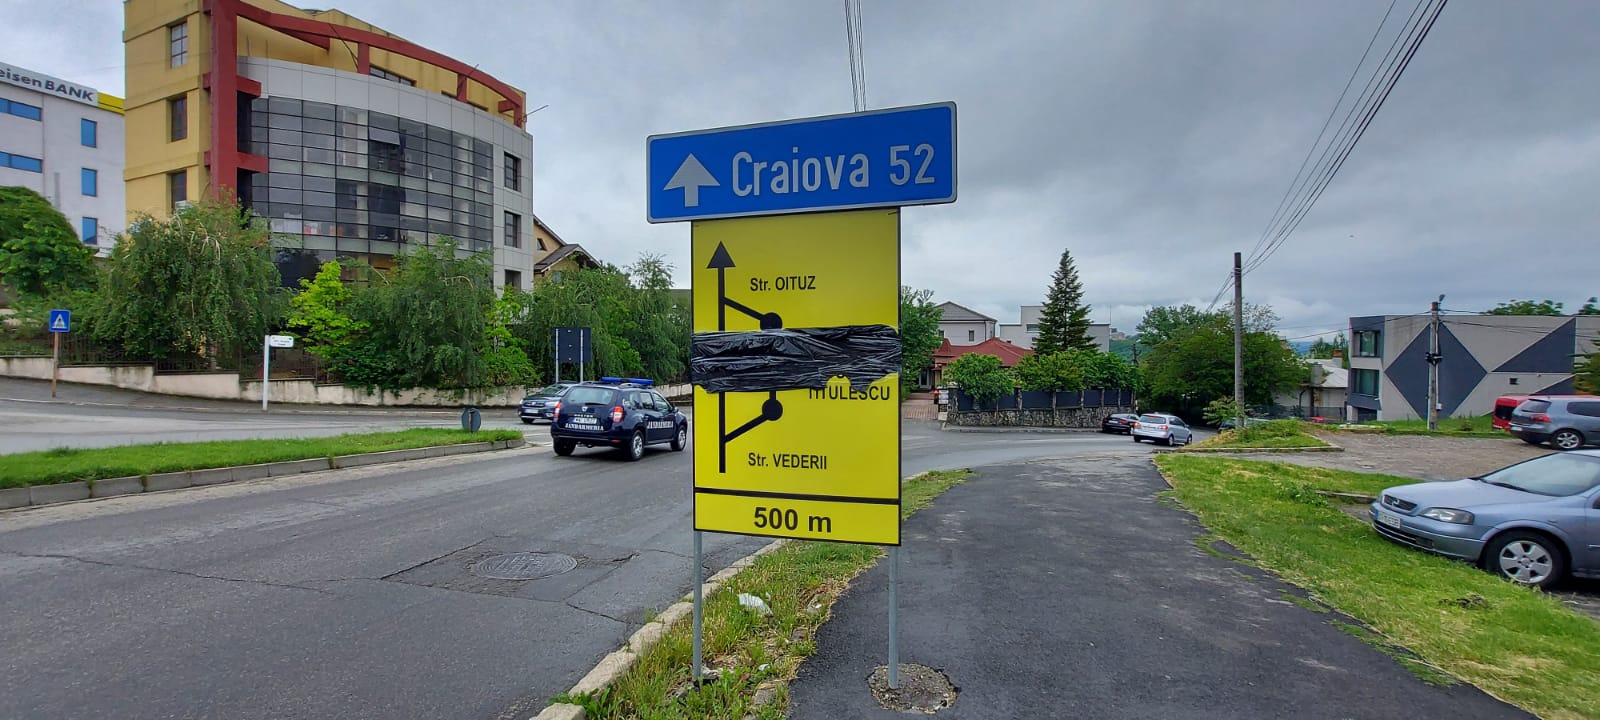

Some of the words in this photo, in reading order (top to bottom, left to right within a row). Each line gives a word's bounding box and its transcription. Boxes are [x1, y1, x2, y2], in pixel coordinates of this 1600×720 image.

[732, 146, 869, 197] Craiova
[889, 143, 935, 186] 52
[750, 277, 771, 291] Str.
[775, 275, 816, 291] OITUZ
[565, 422, 604, 431] JANDARMERIA
[748, 452, 769, 467] Str.
[773, 453, 827, 470] VEDERII
[754, 506, 798, 531] 500
[808, 515, 831, 533] m
